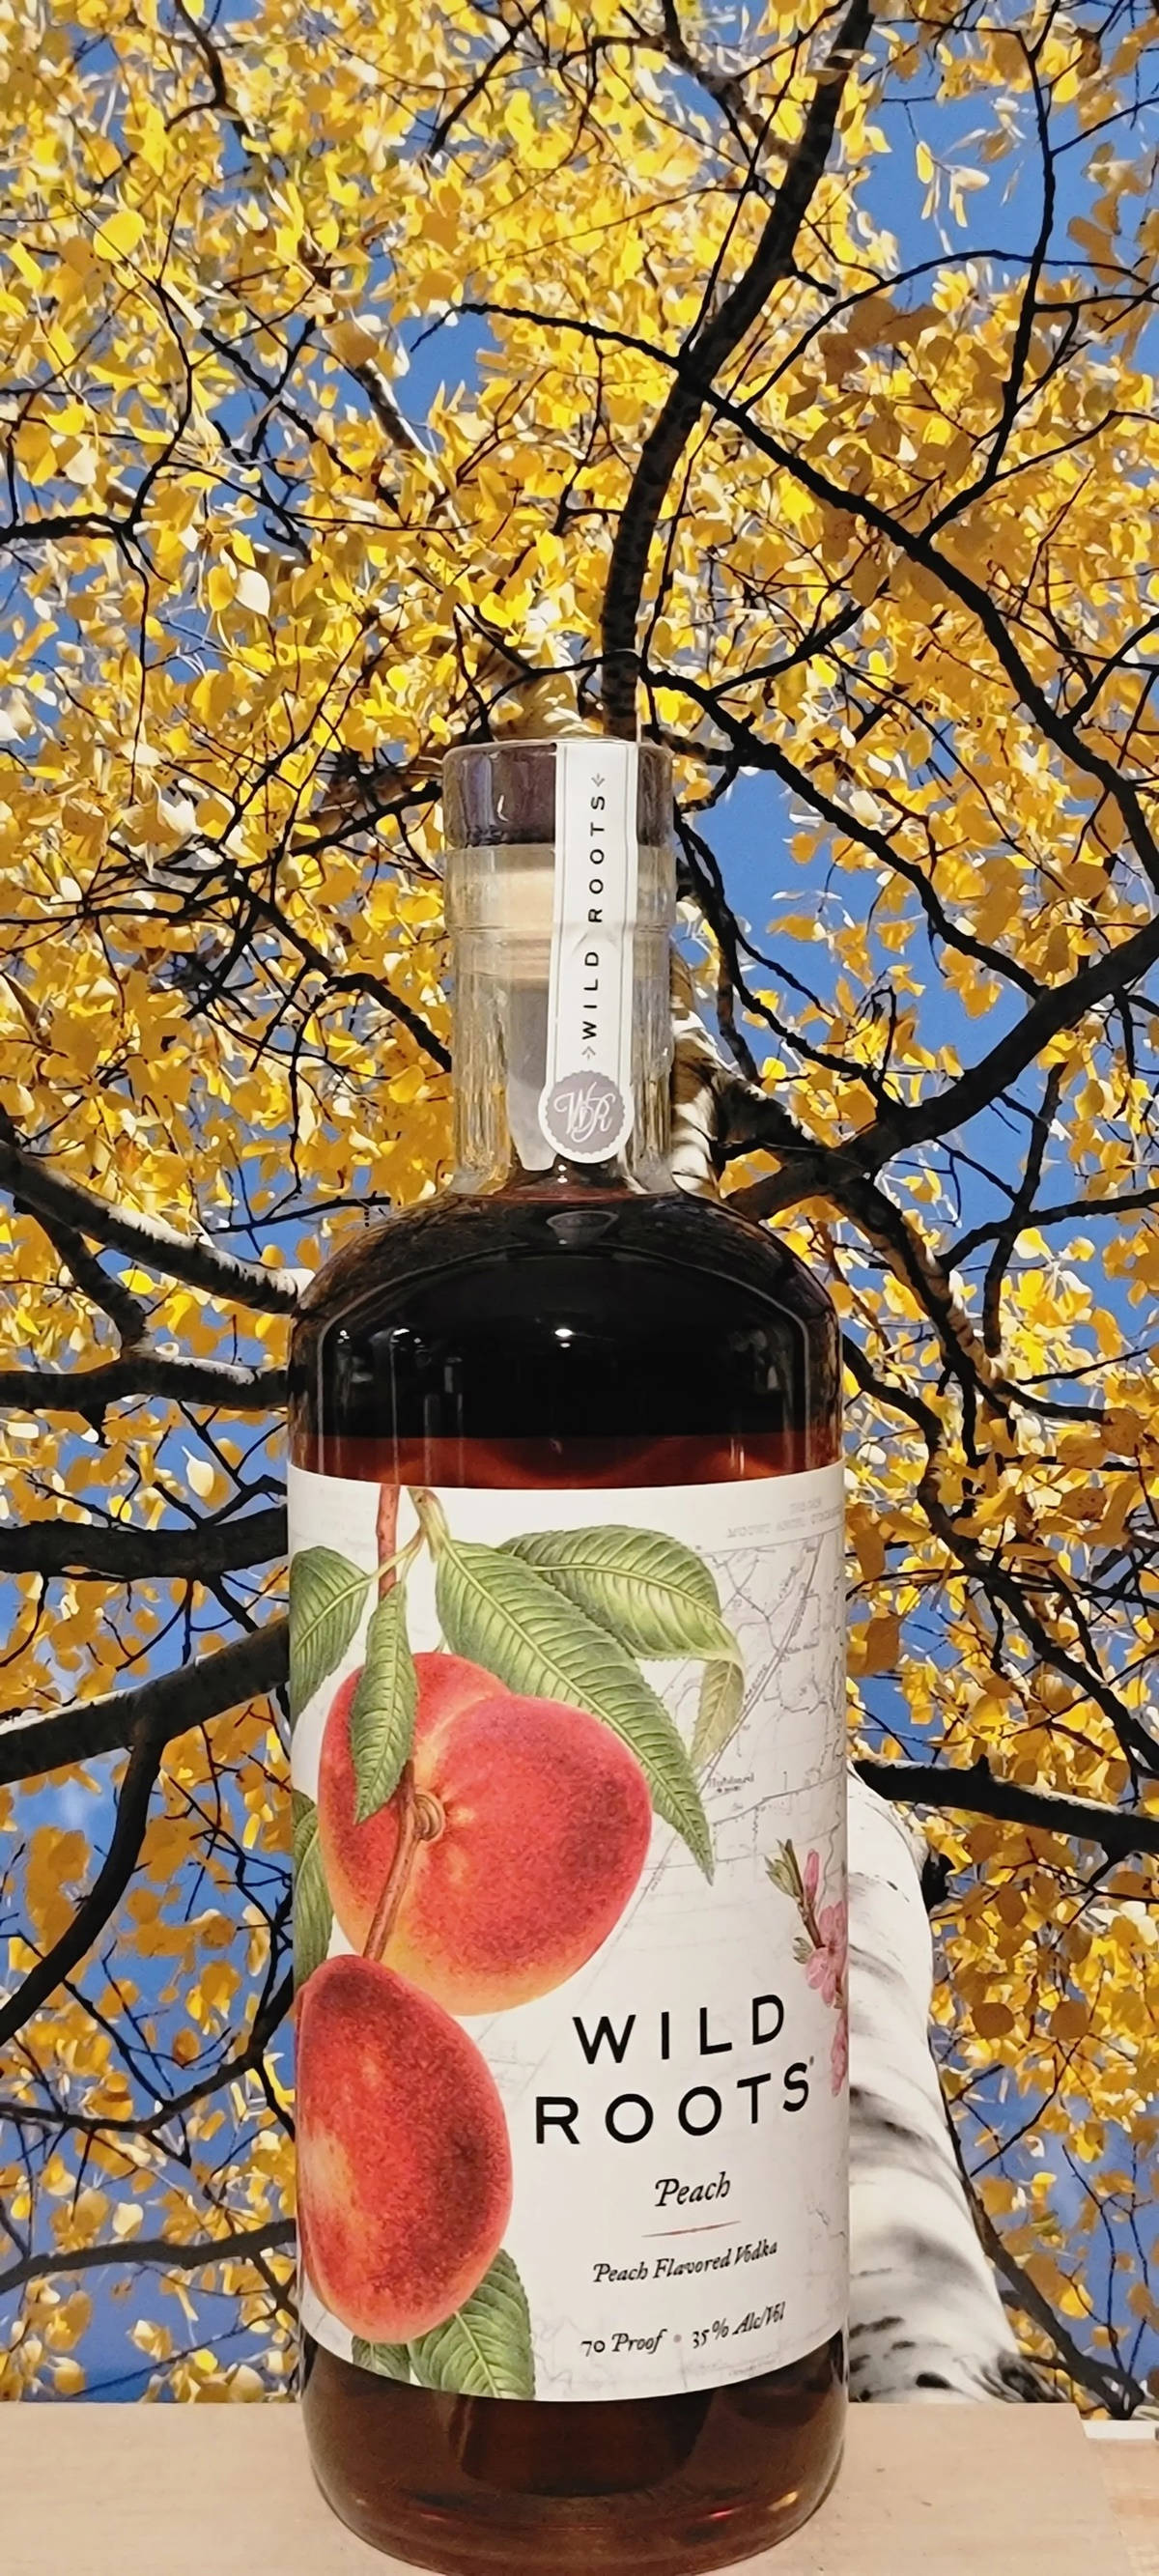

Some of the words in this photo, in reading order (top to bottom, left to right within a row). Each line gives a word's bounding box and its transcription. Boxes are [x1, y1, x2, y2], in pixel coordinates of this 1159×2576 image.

[587, 794, 606, 924] ROOTS
[581, 950, 600, 1040] WILD
[572, 1994, 785, 2065] WILD
[654, 2170, 731, 2207] Peach
[592, 2262, 648, 2282] Peach
[652, 2249, 731, 2279] Flavored
[734, 2237, 778, 2265] Vodka
[580, 2339, 606, 2357] 70
[611, 2328, 668, 2355] Proof
[731, 2301, 786, 2335] Alc/Vol
